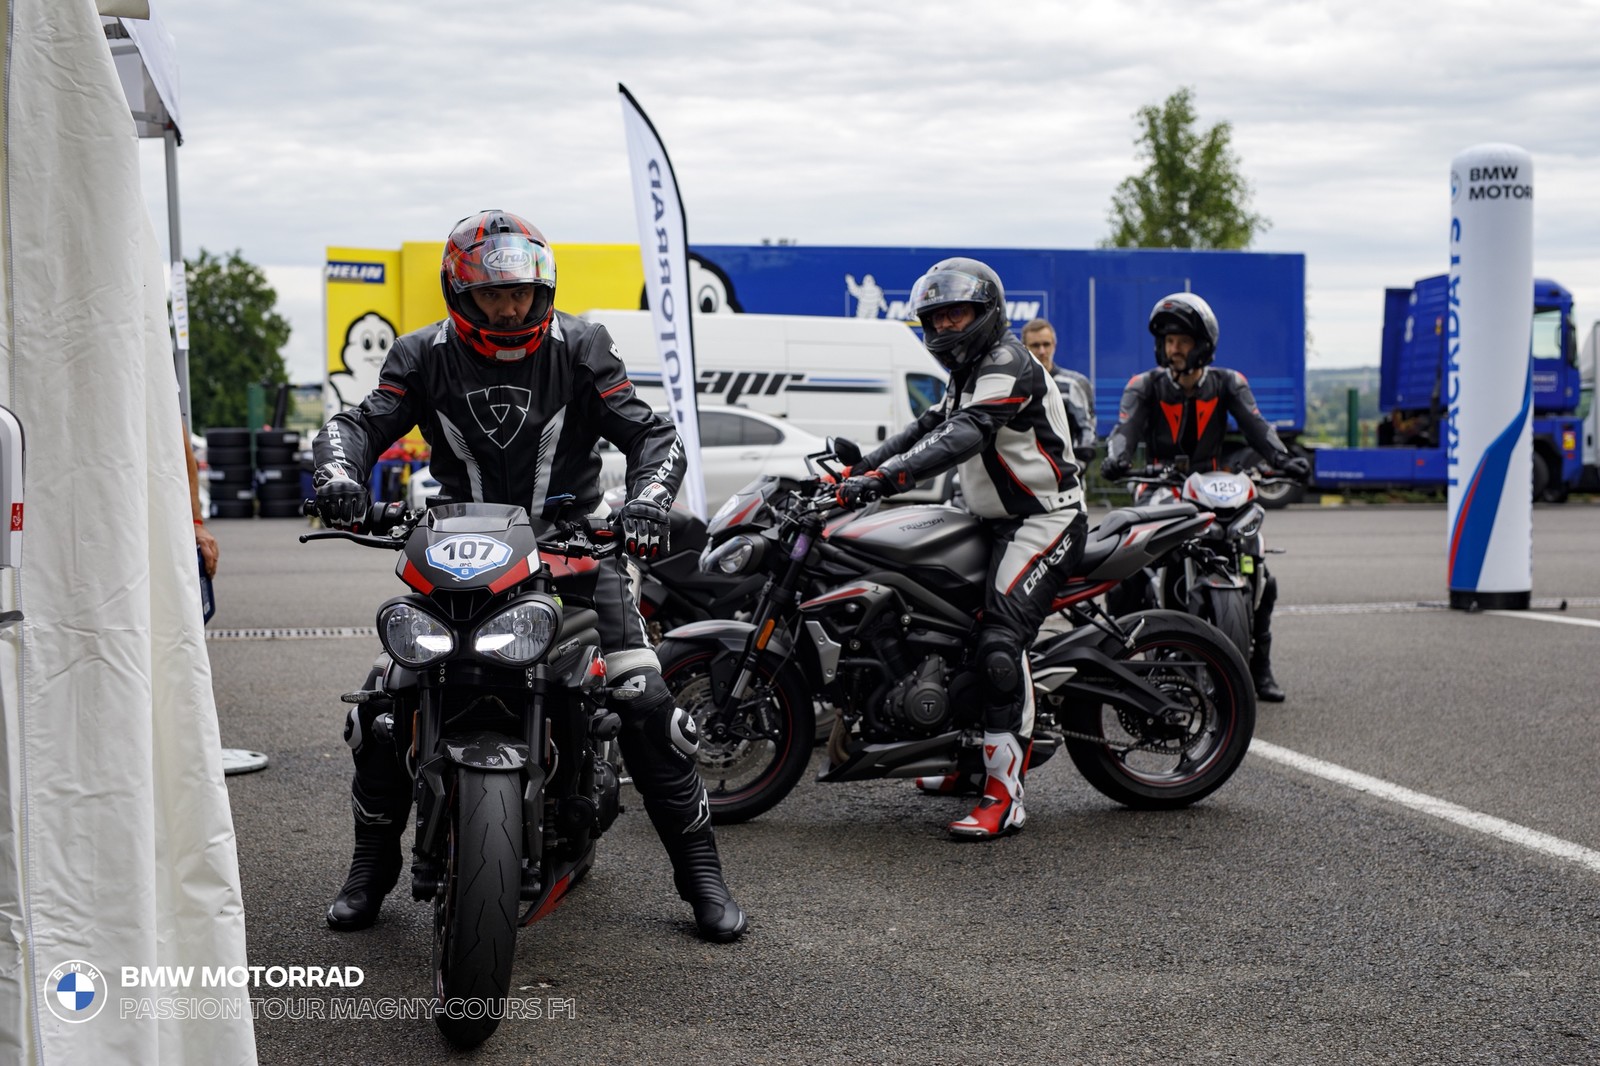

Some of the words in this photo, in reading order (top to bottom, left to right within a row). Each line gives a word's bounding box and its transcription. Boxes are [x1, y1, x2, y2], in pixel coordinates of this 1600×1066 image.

[1470, 166, 1518, 181] BMW
[489, 250, 526, 264] Arai
[1210, 482, 1236, 492] 125
[899, 517, 944, 531] TRIUMPH
[443, 541, 494, 560] 107
